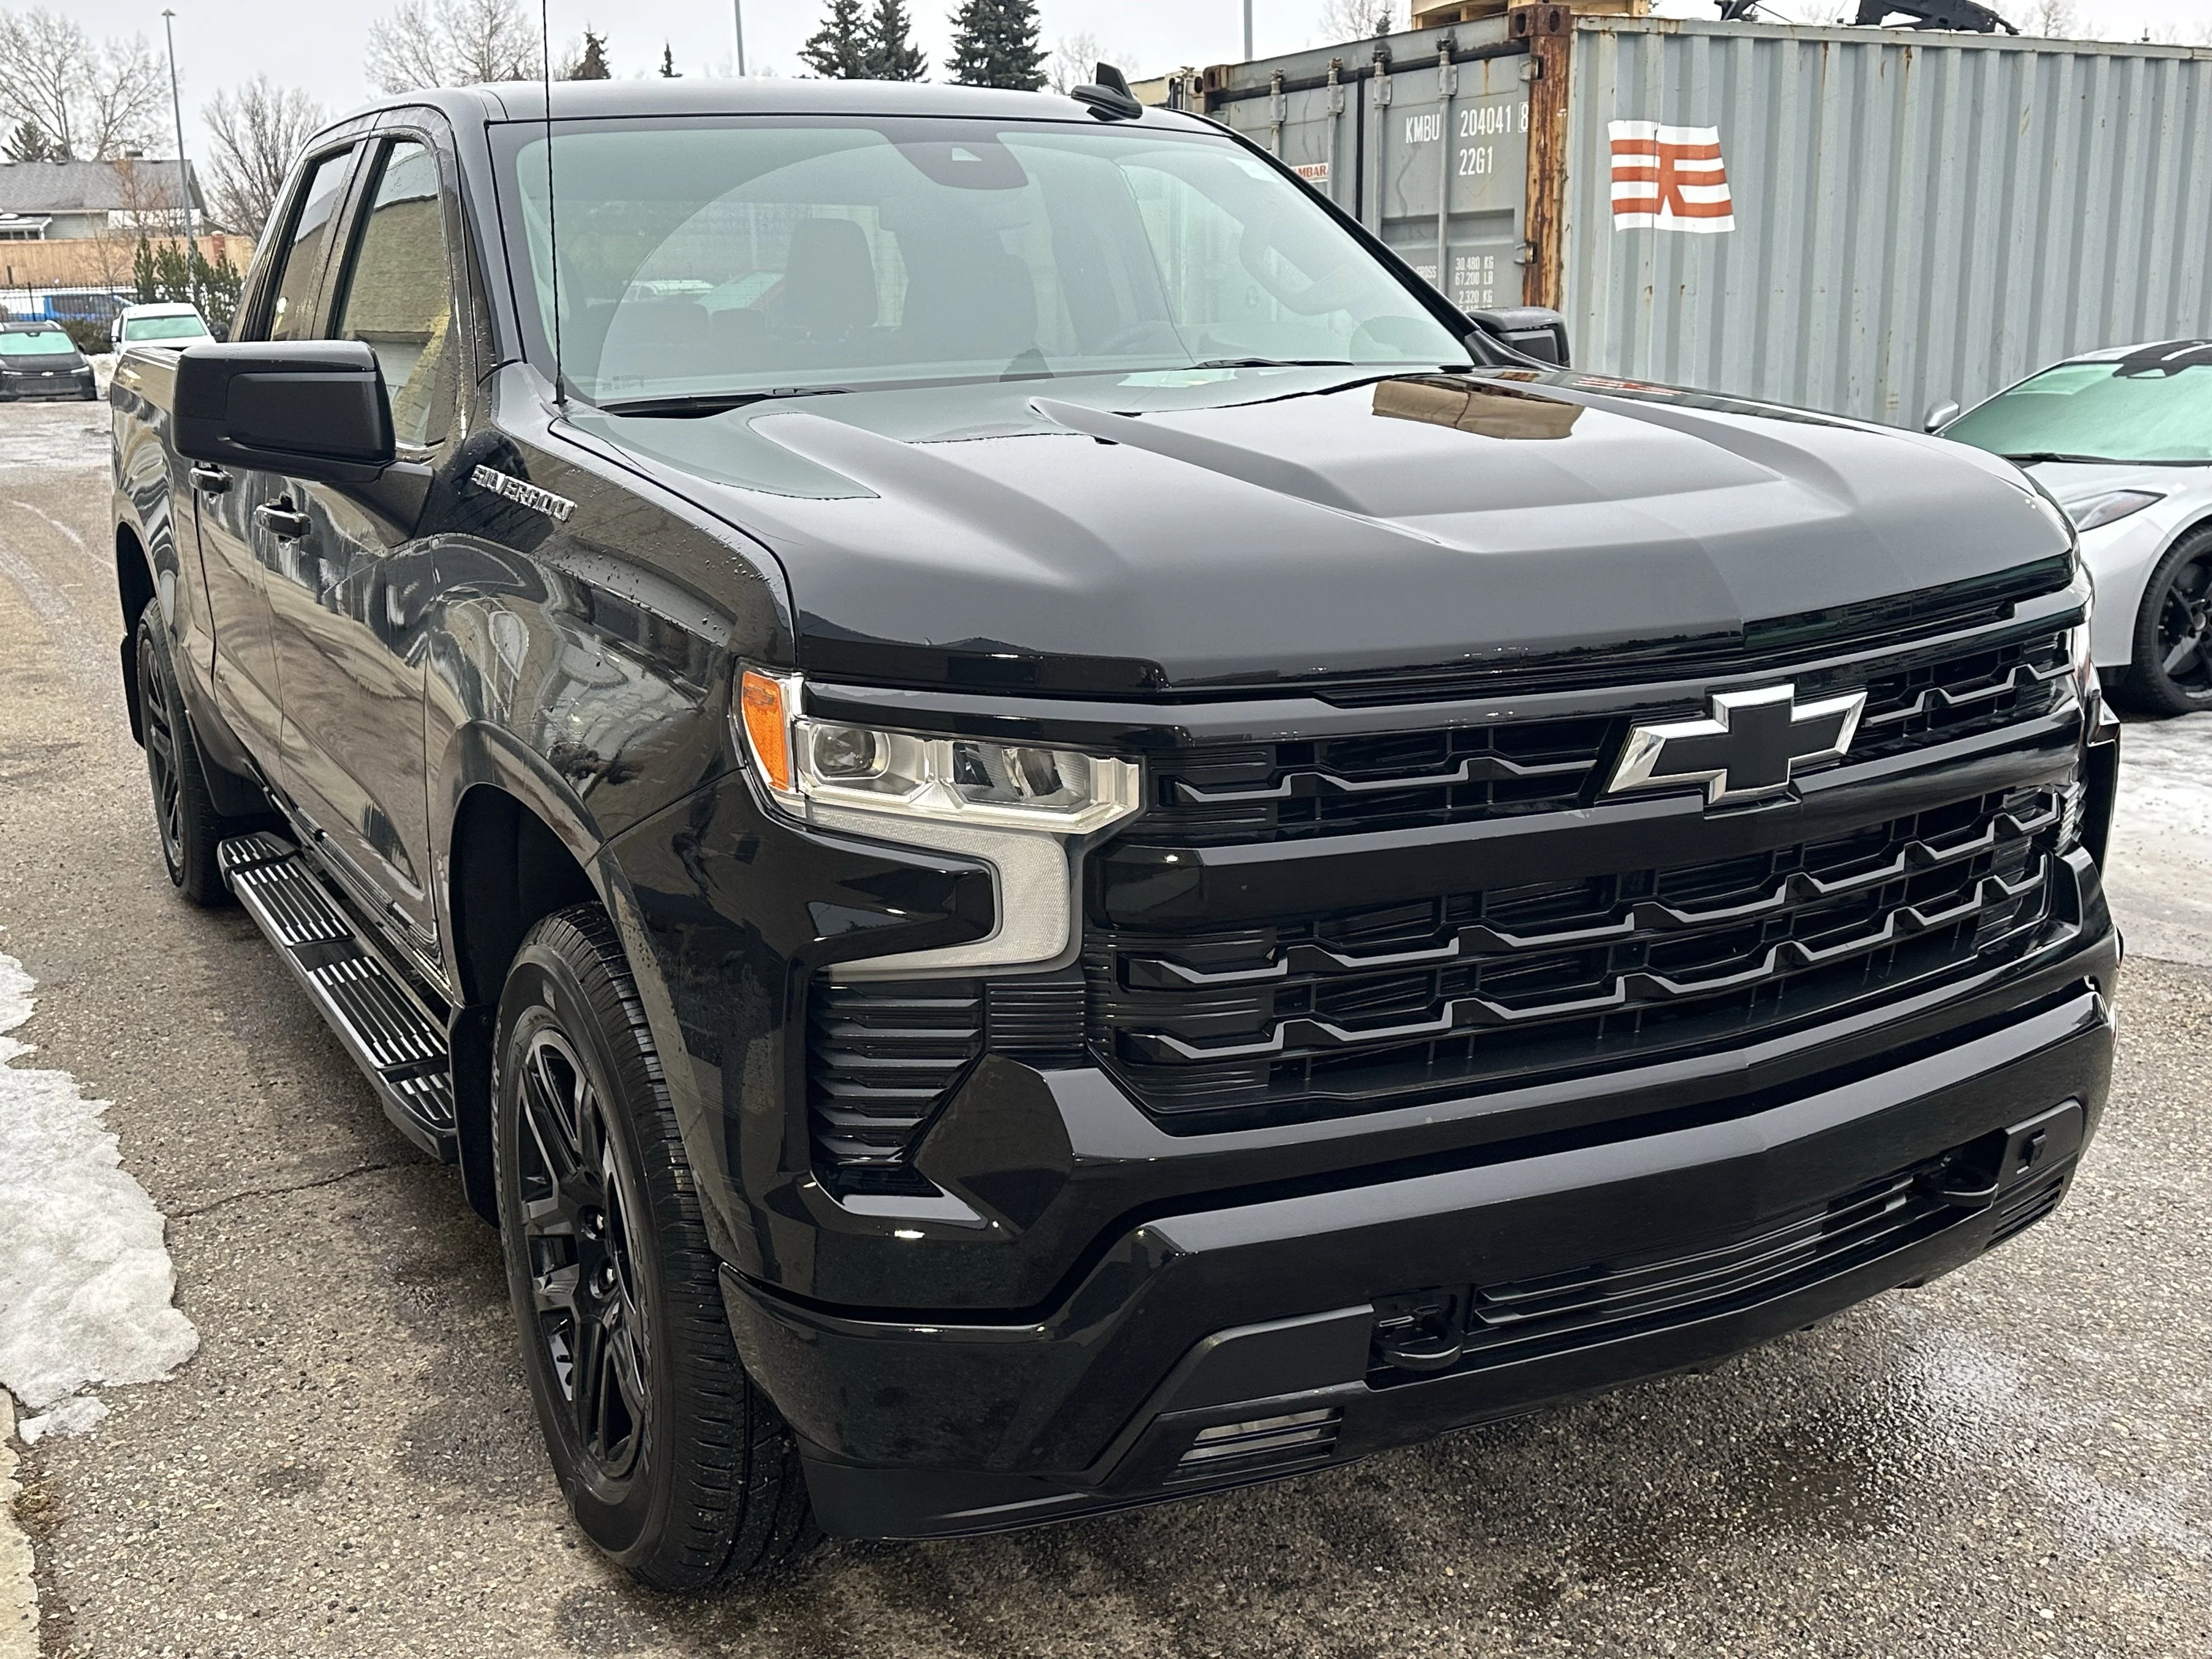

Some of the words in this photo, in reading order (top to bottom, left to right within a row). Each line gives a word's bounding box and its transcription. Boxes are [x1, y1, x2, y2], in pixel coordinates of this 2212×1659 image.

[1406, 114, 1440, 144] KMBU
[1460, 105, 1511, 137] 204041
[1520, 104, 1529, 131] 8
[1484, 256, 1494, 269] KG
[1483, 271, 1493, 285] LB
[1483, 290, 1493, 303] KG
[471, 464, 578, 522] SILVERADO
